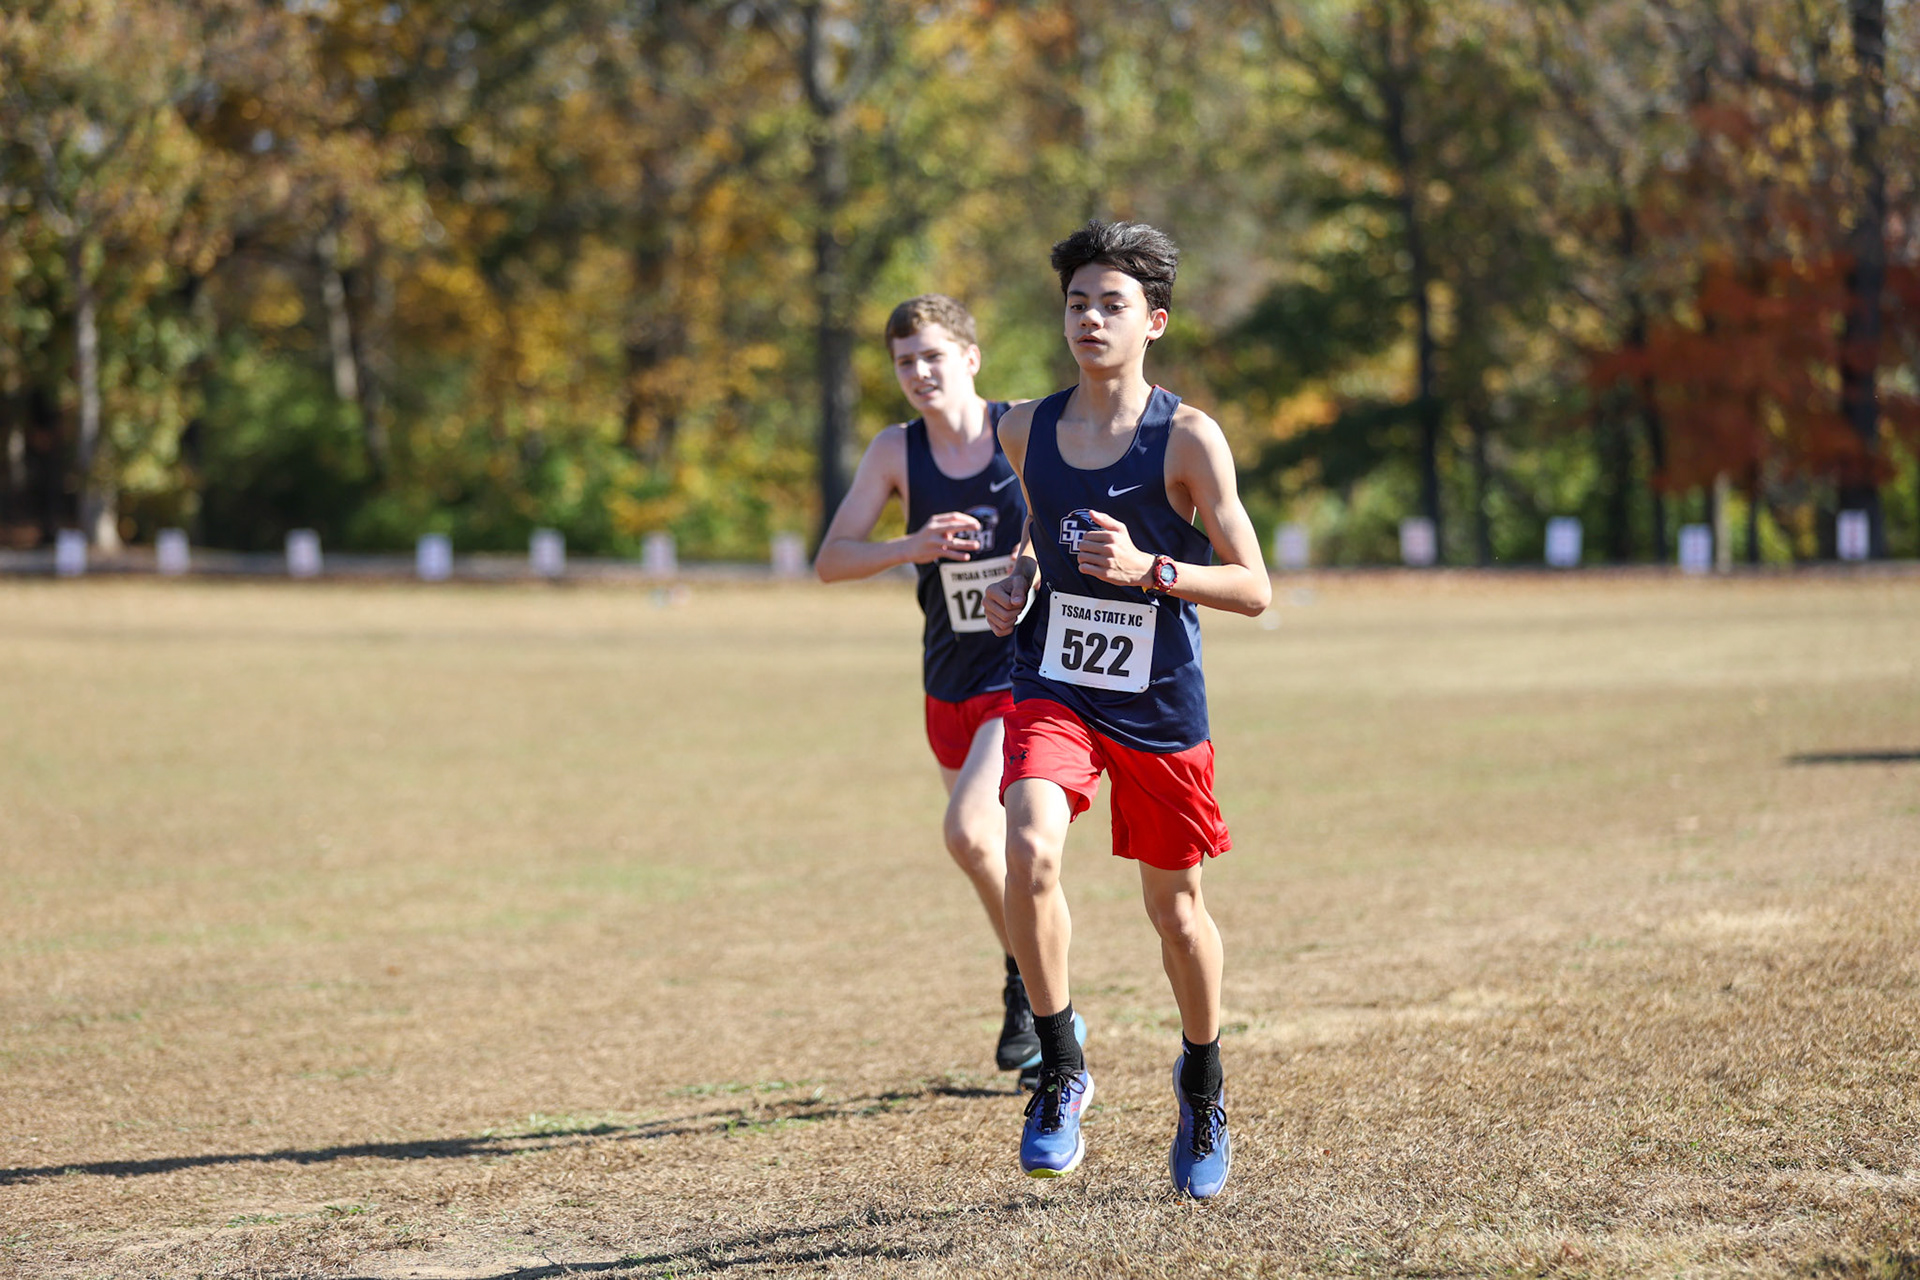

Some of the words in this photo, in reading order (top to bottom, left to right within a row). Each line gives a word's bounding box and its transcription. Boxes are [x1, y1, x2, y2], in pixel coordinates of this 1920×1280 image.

[1061, 604, 1091, 621] TSSAA
[1094, 609, 1126, 625] STATE
[1128, 614, 1143, 627] XC
[1061, 628, 1133, 677] 522
